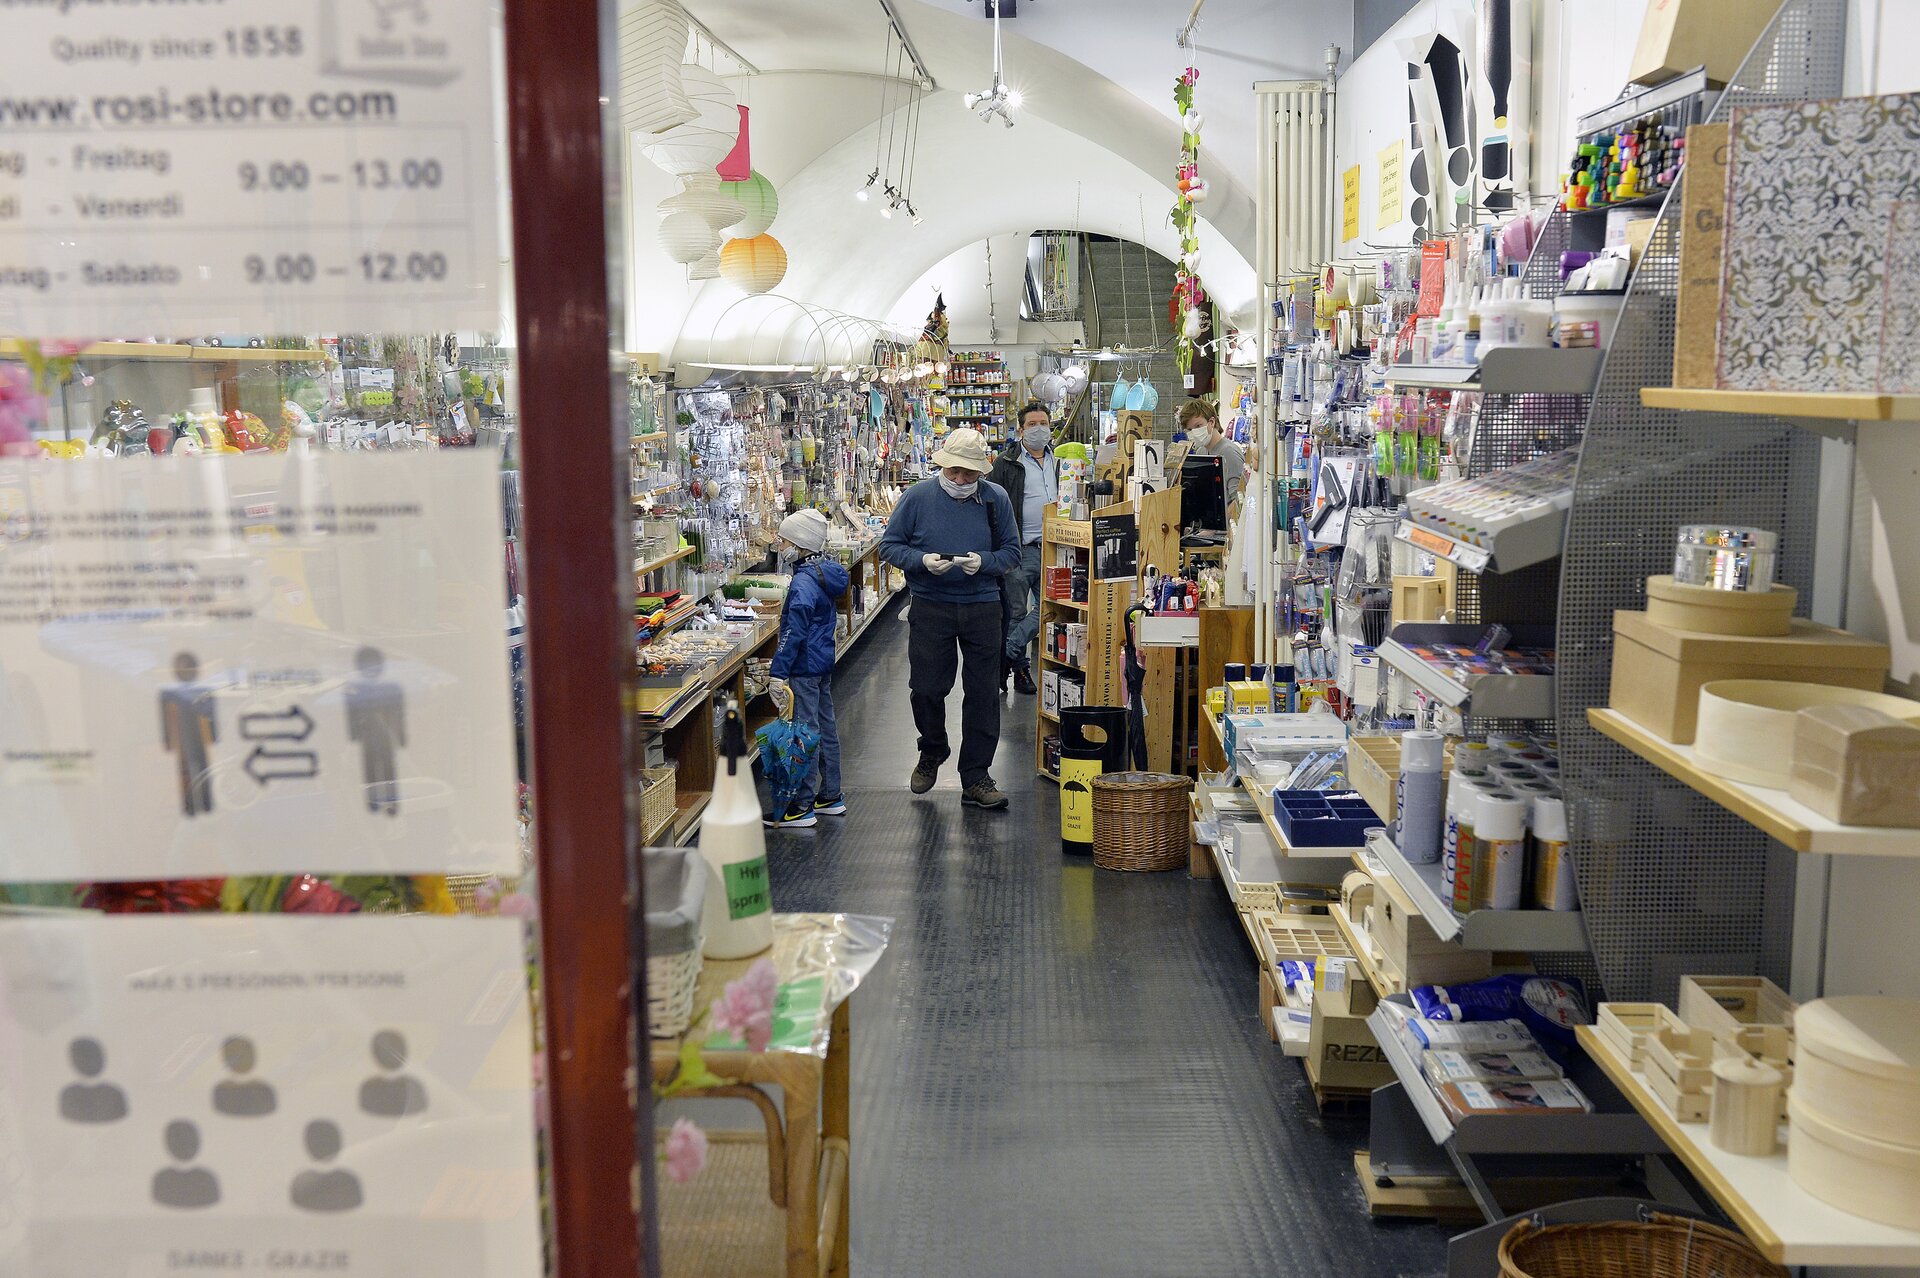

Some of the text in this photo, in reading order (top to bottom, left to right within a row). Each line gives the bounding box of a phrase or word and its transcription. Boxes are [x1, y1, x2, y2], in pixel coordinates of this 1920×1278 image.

[52, 25, 304, 64] Quality since 1858
[0, 87, 397, 123] ww.rosi-store.com
[73, 145, 170, 173] Freitag
[238, 161, 310, 190] 9.00
[352, 158, 442, 189] 13.00
[81, 260, 181, 286] Sabato
[244, 255, 315, 284] 9.00
[358, 252, 447, 282] 12.00
[1105, 669, 1110, 680] DE
[1446, 816, 1459, 884] COLOR
[1453, 825, 1473, 902] HAPPY
[168, 1251, 244, 1270] DANKE
[267, 1250, 350, 1270] GRAZIE
